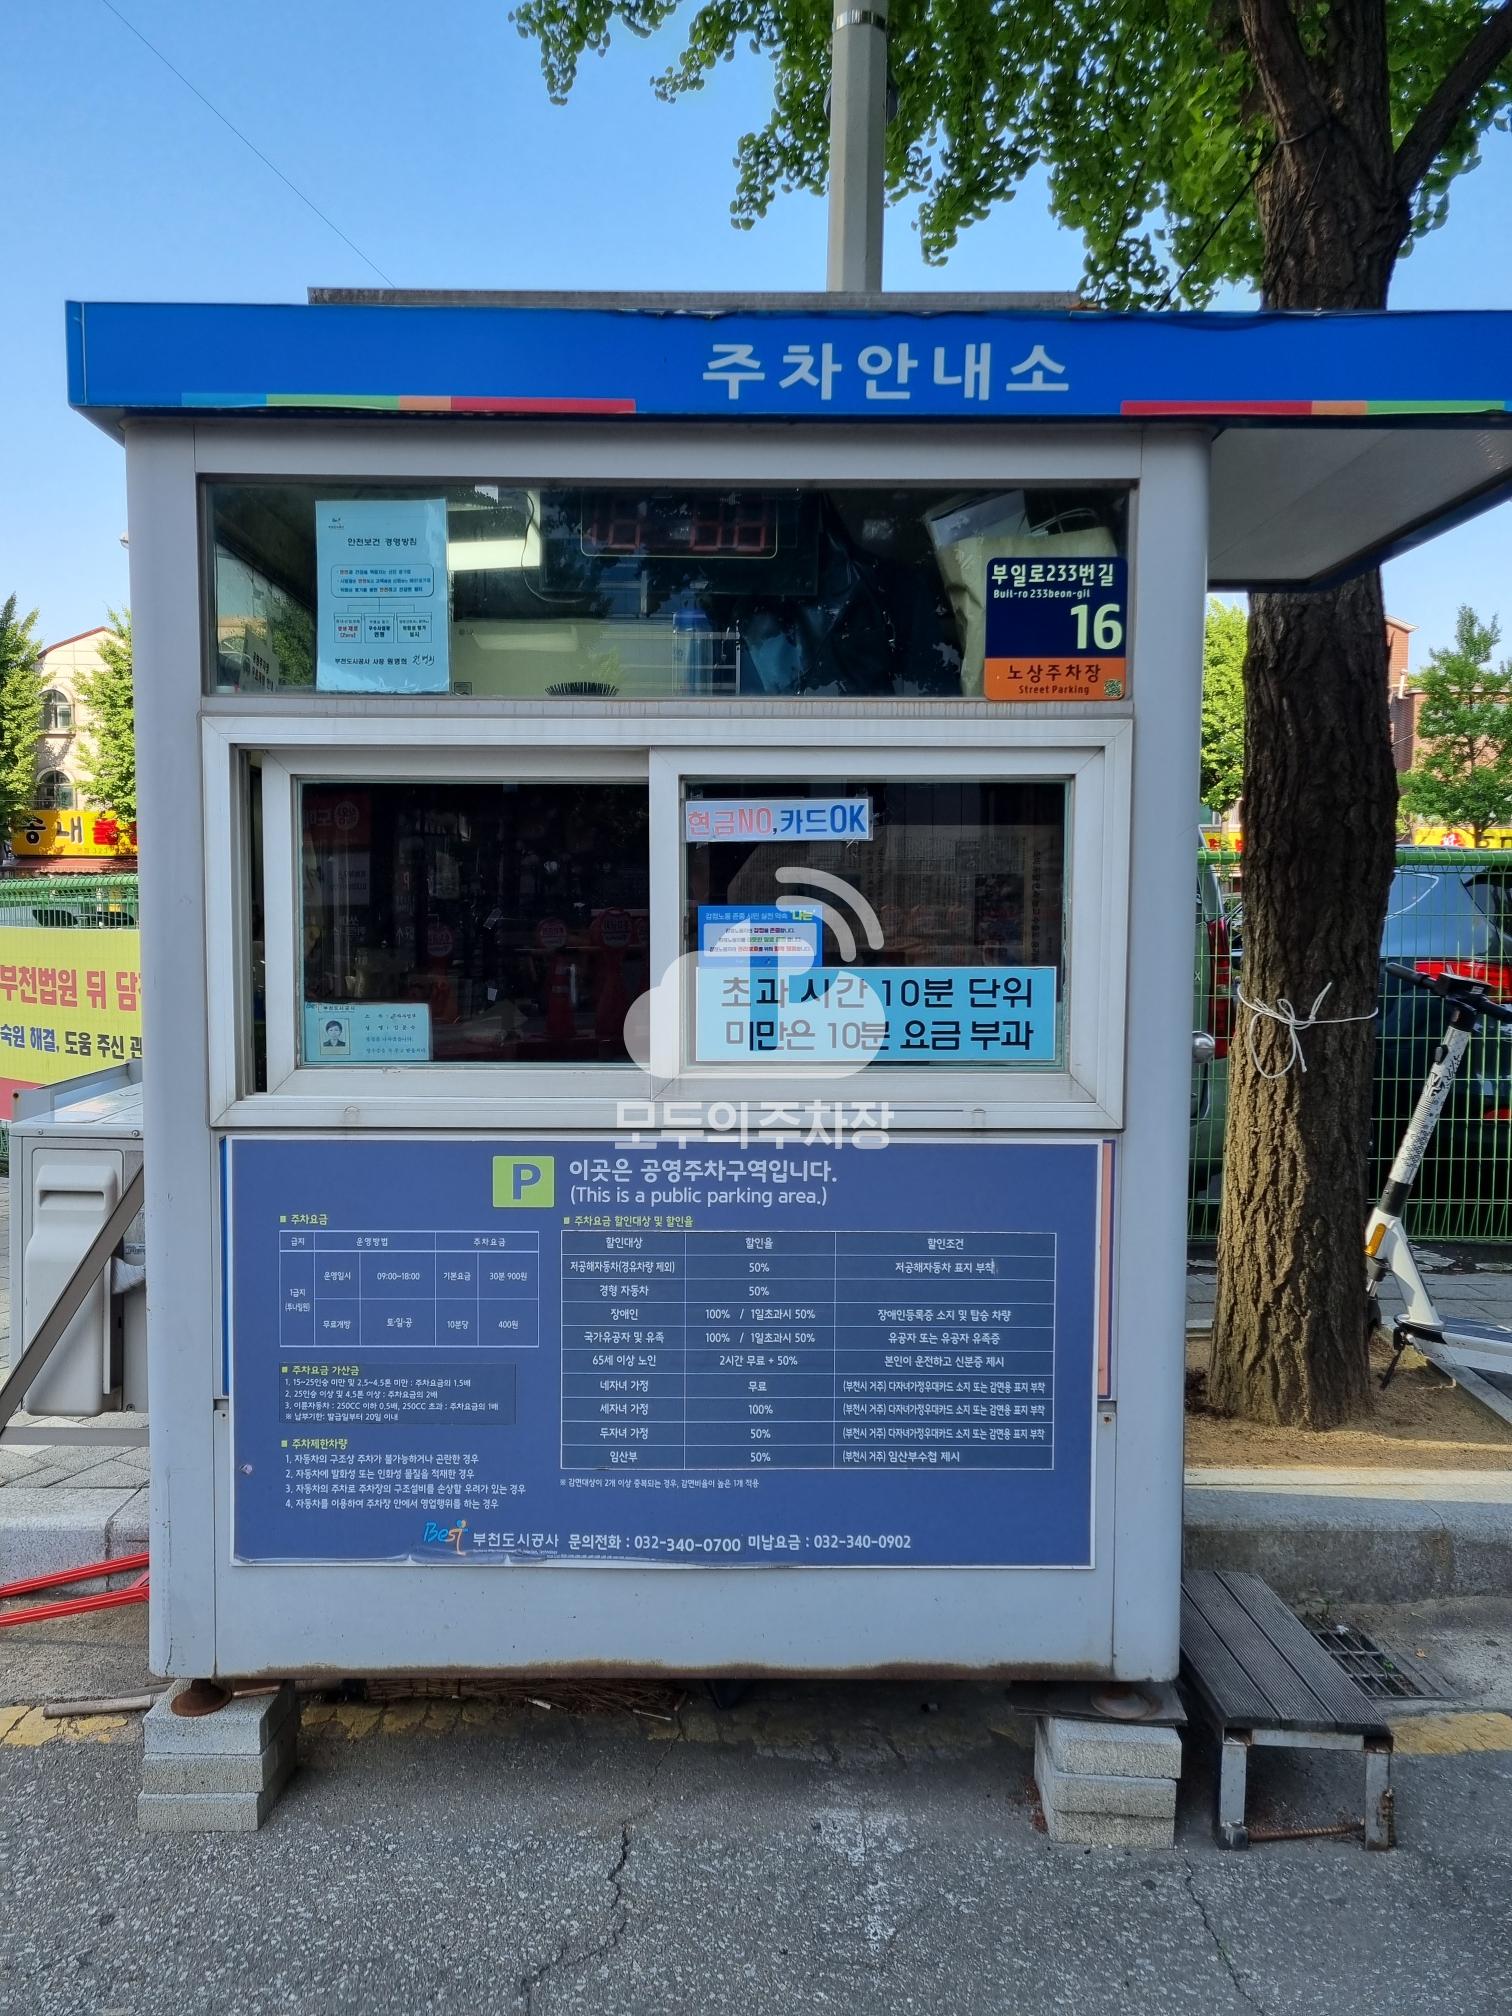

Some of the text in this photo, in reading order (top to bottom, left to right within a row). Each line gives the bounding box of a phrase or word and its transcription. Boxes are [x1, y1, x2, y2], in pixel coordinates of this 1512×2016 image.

[702, 342, 1069, 400] 주차안내소
[991, 564, 1114, 588] 부일로233번길
[994, 588, 1091, 600] Buil-ro 233beon-gil
[1070, 603, 1123, 650] 16
[1008, 664, 1102, 684] 노상주차장
[1019, 684, 1090, 695] Street Parking
[688, 804, 867, 837] 현금NO,카드OK
[0, 965, 142, 1012] 부천법원 뒤 담
[722, 978, 1033, 1008] 초과 시간 10분 단위
[726, 1020, 1034, 1051] 미만은 10분 요금 부과
[0, 1024, 25, 1048] 숙원
[30, 1026, 60, 1053] 해결,
[65, 1030, 91, 1056] 도움
[97, 1034, 124, 1060] 주신
[569, 1158, 838, 1184] 이곳은 공영주차구역입니다.
[512, 1163, 542, 1200] P
[570, 1187, 827, 1208] (This is a public parking area.)
[290, 1214, 328, 1225] 주차요금
[574, 1216, 694, 1227] 주차요금 할인대상 및 할인율
[290, 1237, 305, 1247] 급지
[356, 1237, 388, 1247] 운영방법
[473, 1238, 506, 1247] 주차요금
[605, 1237, 643, 1248] 할인대상
[745, 1237, 774, 1249] 할인율
[927, 1238, 964, 1250] 할인조건
[570, 1261, 675, 1273] 저공해자동차(경유차량 제외)
[749, 1262, 770, 1272] 50%
[895, 1262, 951, 1274] 저공해자동차
[954, 1262, 972, 1274] 표지
[323, 1271, 351, 1281] 운영일시
[376, 1272, 420, 1281] 09:00~18:00
[442, 1272, 471, 1281] 기본요금
[489, 1272, 527, 1281] 30분 900원
[600, 1285, 649, 1297] 경형 자동차
[749, 1286, 770, 1296] 50%
[610, 1309, 639, 1320] 장애인
[705, 1310, 730, 1319] 100%
[751, 1309, 791, 1320] 1일초과시
[794, 1310, 815, 1319] 50%
[878, 1310, 1011, 1321] 장애인등록증 소지 및 탑승 차량
[323, 1320, 351, 1329] 무료개방
[447, 1320, 469, 1329] 10분당
[498, 1321, 519, 1329] 400원
[584, 1332, 664, 1343] 국가유공자 및 유족
[705, 1333, 730, 1343] 100%
[751, 1333, 791, 1344] 1일초과시
[794, 1333, 815, 1343] 50%
[888, 1333, 1000, 1344] 유공자 또는 유공자 유족증
[592, 1356, 656, 1366] 65세 이상 노인
[719, 1356, 798, 1366] 2시간 무료 50%
[885, 1356, 1004, 1368] 본인이 운전하고 신분증 제시
[292, 1366, 359, 1376] 주차요금 가산금
[600, 1380, 649, 1392] 네자녀 가정
[748, 1382, 767, 1392] 무료
[843, 1381, 867, 1393] (부천시
[870, 1381, 886, 1393] 거주)
[956, 1381, 970, 1393] 소지
[973, 1381, 988, 1393] 또는
[990, 1381, 1012, 1393] 감면용
[1014, 1381, 1028, 1393] 표지
[1031, 1381, 1045, 1393] 부착
[600, 1404, 649, 1415] 세자녀 가정
[748, 1405, 773, 1415] 100%
[600, 1428, 649, 1439] 두자녀 가정
[750, 1429, 771, 1439] 50%
[292, 1439, 348, 1450] 주차제한차량
[294, 1454, 327, 1464] 자동차의
[330, 1454, 355, 1464] 구조상
[357, 1454, 382, 1464] 주차가
[385, 1454, 434, 1464] 불가능하거나
[436, 1454, 460, 1464] 곤란한
[463, 1454, 479, 1464] 경우
[609, 1452, 638, 1462] 임산부
[750, 1452, 771, 1462] 50%
[843, 1450, 960, 1463] (부천시 거주) 임산부수첩 제시
[473, 1533, 911, 1552] 부천도시공사 문의전화 032-340-0700 미납요금 032-340-0902
